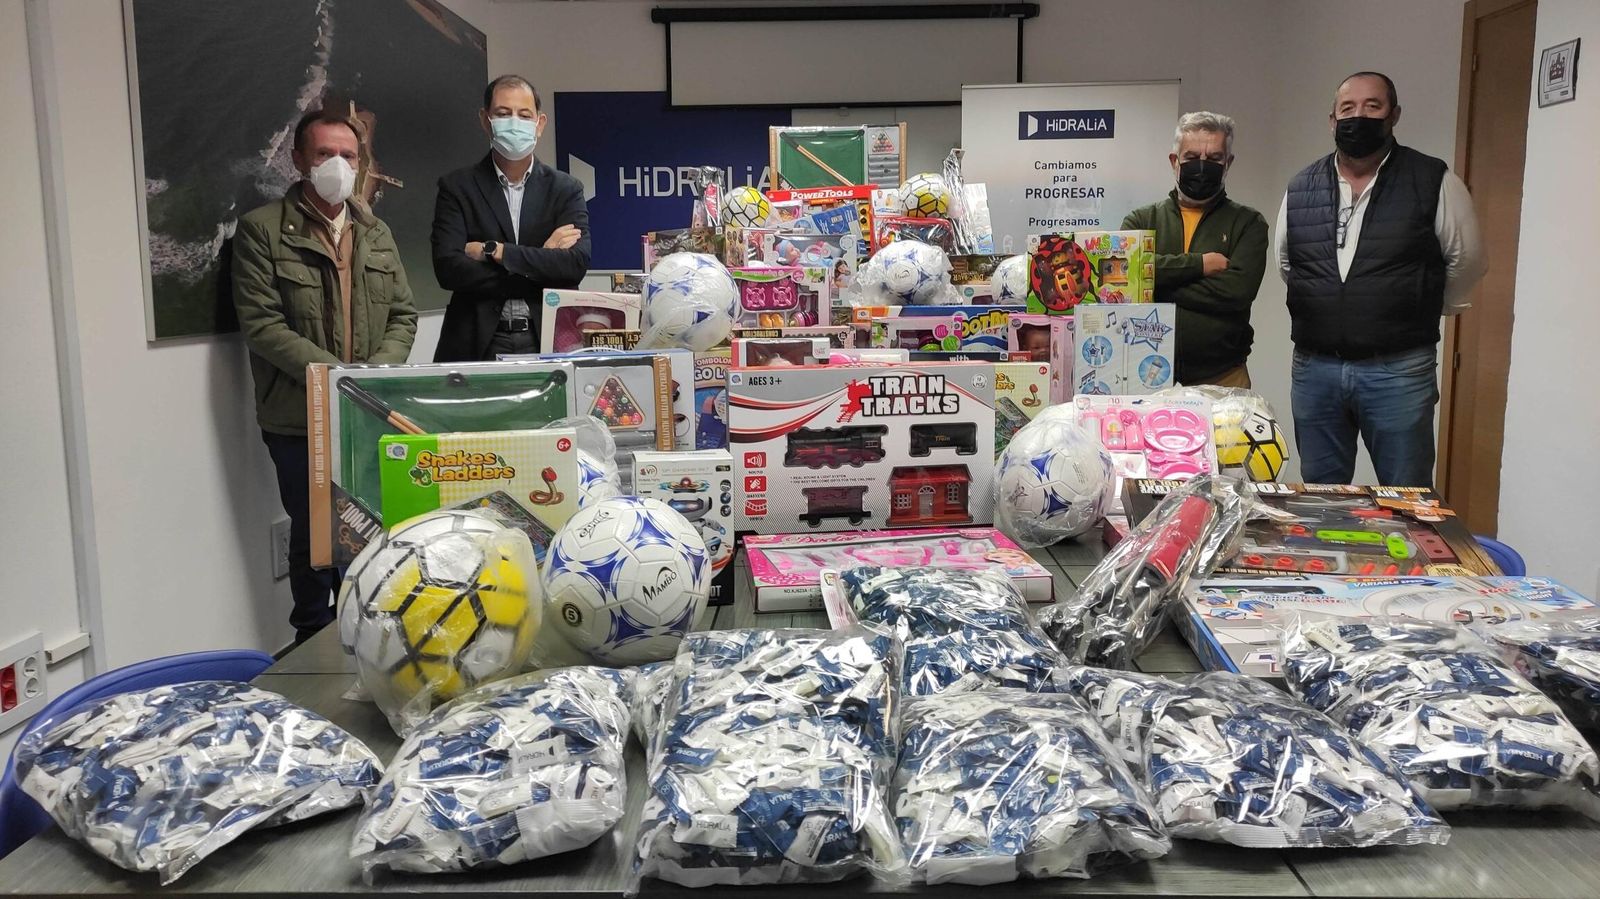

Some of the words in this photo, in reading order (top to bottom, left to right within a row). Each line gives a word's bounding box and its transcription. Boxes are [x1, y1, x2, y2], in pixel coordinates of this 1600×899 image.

[1034, 160, 1097, 170] Cambiamos
[618, 166, 770, 197] HiDRLiA
[1053, 173, 1078, 185] para
[1025, 187, 1105, 199] PROGRESAR
[1028, 217, 1100, 229] Progresamos
[592, 336, 605, 345] SET
[748, 377, 768, 386] AGES
[769, 377, 782, 385] 3+
[869, 375, 945, 396] TRAIN
[861, 394, 959, 416] TRACKS
[558, 441, 570, 449] 6+
[417, 450, 497, 468] Snakes
[432, 465, 516, 483] Ladders
[339, 502, 373, 534] POOL
[1353, 580, 1399, 588] VARIABLE
